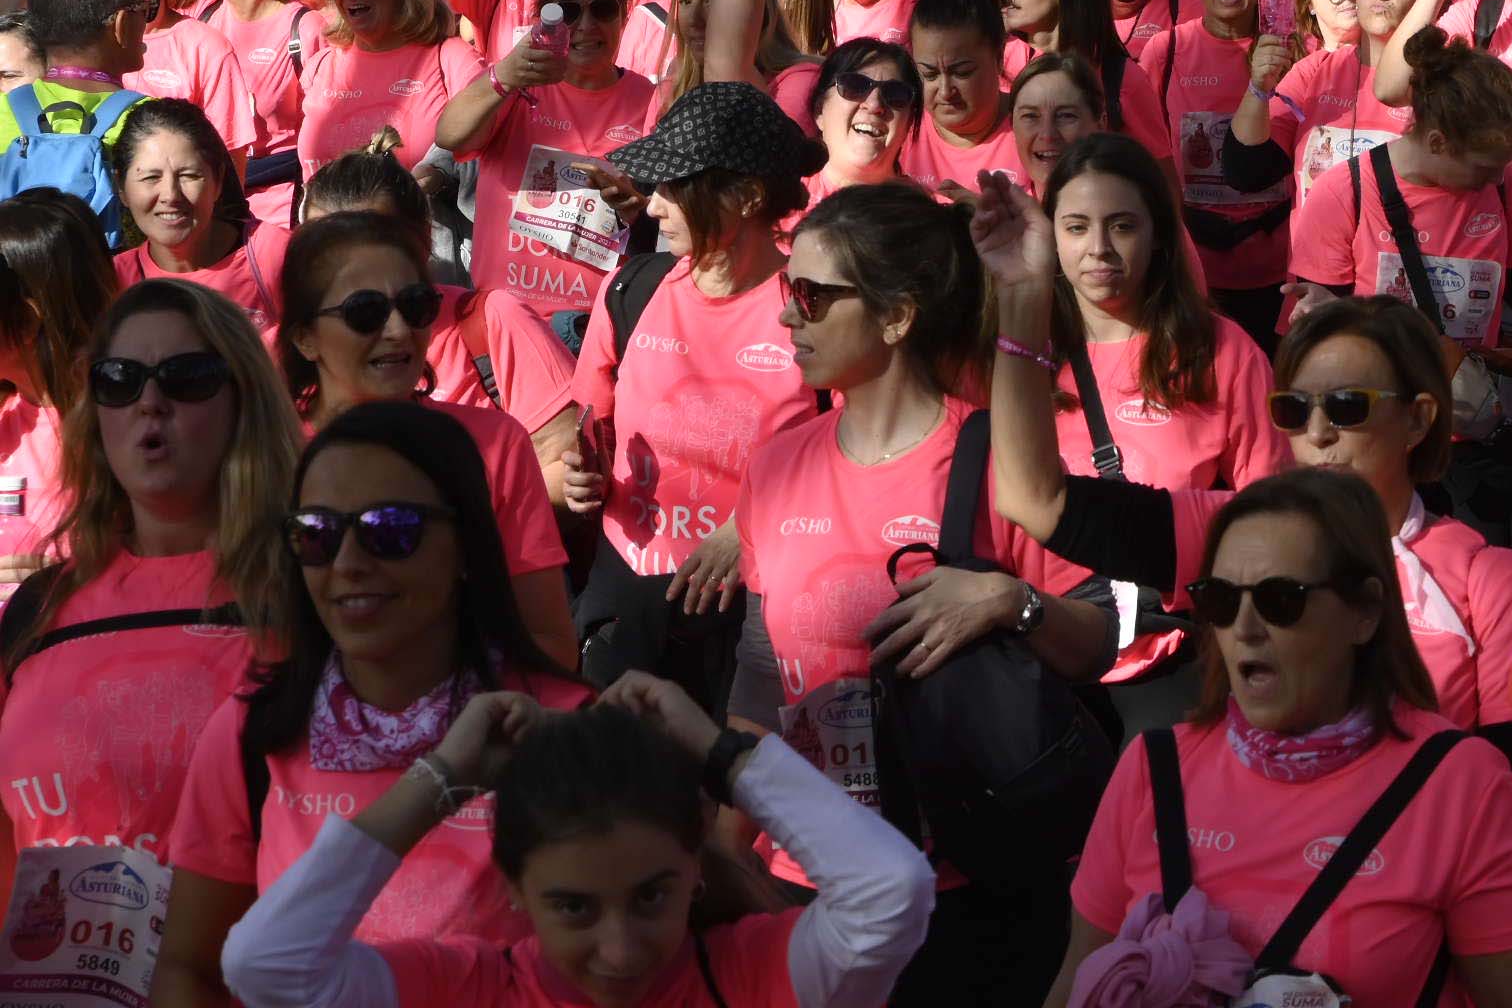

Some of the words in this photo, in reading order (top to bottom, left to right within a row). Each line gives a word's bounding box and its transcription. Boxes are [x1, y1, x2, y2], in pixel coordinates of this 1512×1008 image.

[1180, 75, 1218, 88] OYSHO
[560, 192, 597, 212] 016
[559, 210, 587, 224] 30541
[507, 262, 588, 298] SUMA
[635, 333, 689, 355] OYSHO
[739, 352, 790, 367] ASTURIANA
[823, 706, 872, 722] ASTURI
[830, 743, 870, 767] 01
[11, 772, 67, 820] TU
[1153, 828, 1236, 852] SHO
[77, 878, 144, 904] ASTURIANA
[71, 920, 136, 955] 016
[76, 953, 121, 976] 5849
[13, 977, 69, 990] CARRERA
[71, 979, 89, 991] DE
